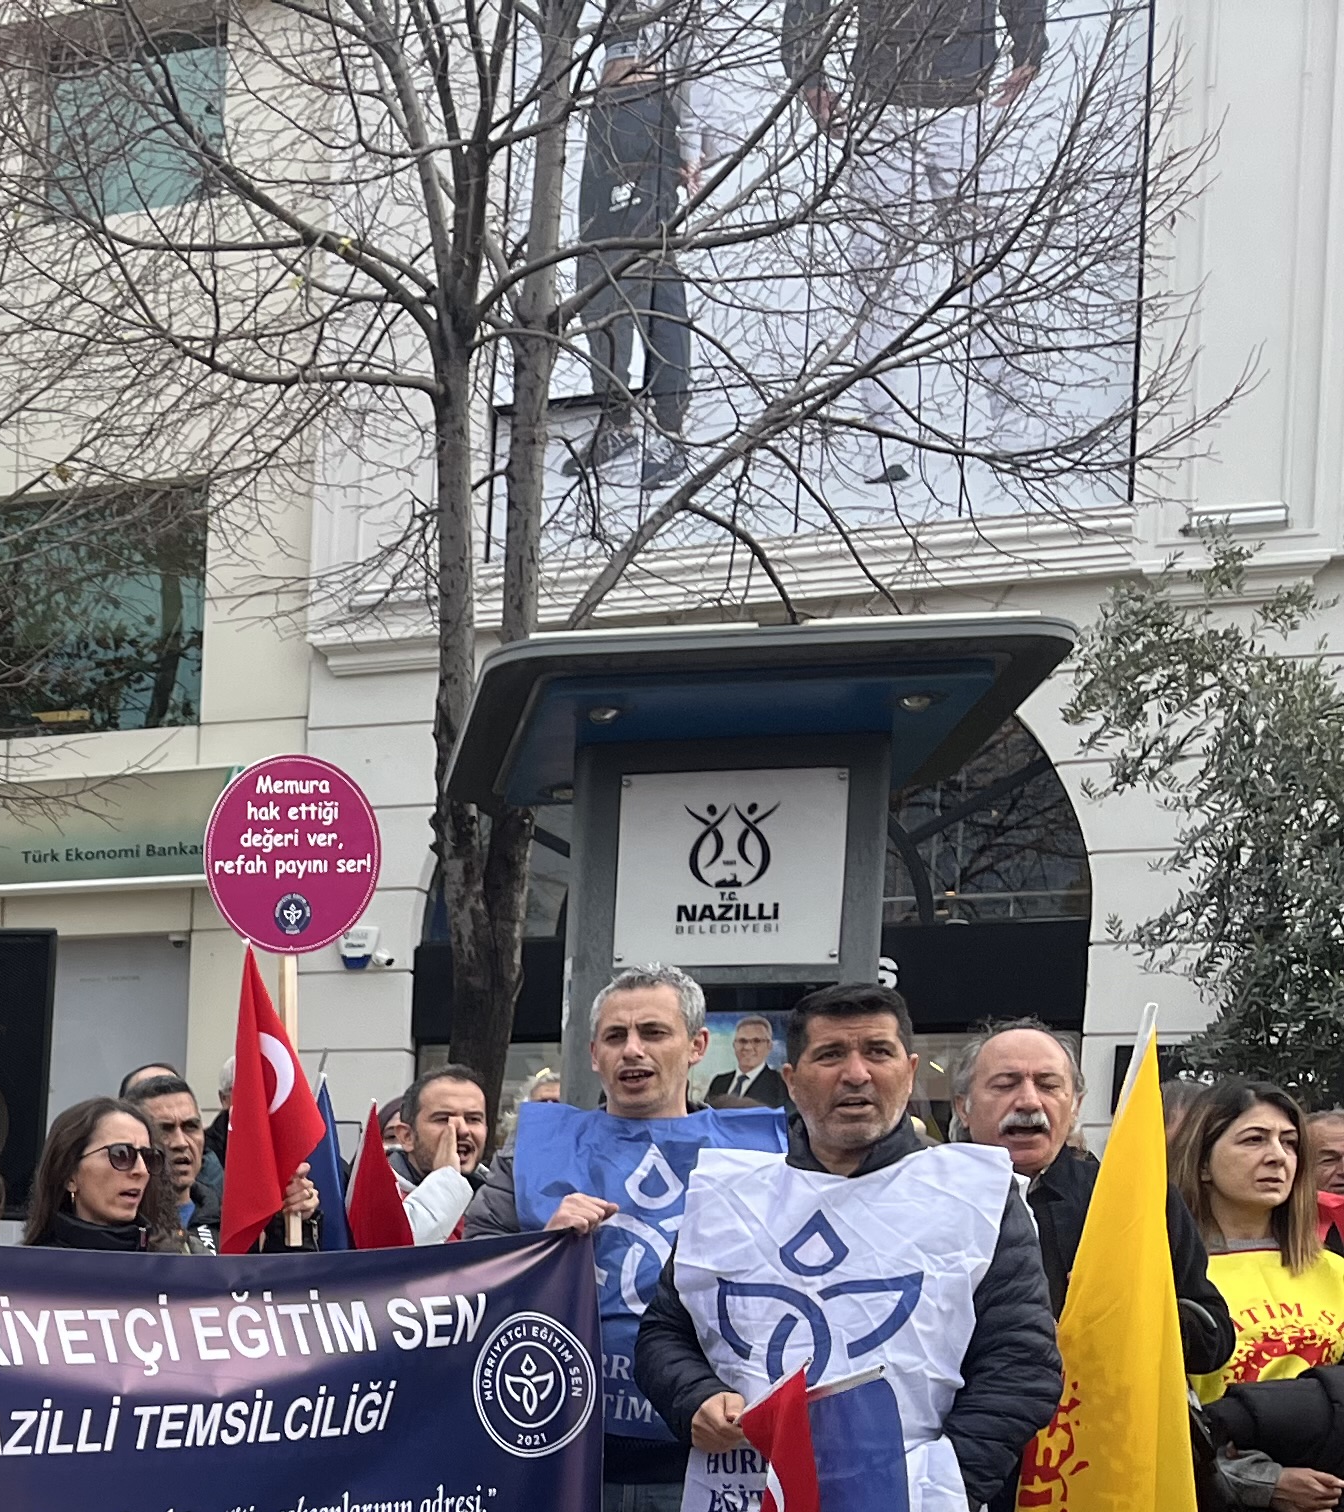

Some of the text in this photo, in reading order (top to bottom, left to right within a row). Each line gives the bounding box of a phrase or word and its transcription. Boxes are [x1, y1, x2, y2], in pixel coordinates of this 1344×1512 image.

[255, 775, 331, 796] Memura
[246, 800, 340, 827] hak ettiği
[239, 828, 345, 853] değeri ver,
[21, 843, 206, 866] Türk Ekonomi Bankas
[214, 854, 373, 880] refah payını ser!
[190, 1289, 378, 1363] EĞİTİM
[386, 1292, 488, 1352] SEN
[481, 1323, 527, 1401] HÜRRİYETÇİ
[531, 1325, 574, 1363] EĞİTİM
[568, 1366, 583, 1398] SEN
[132, 1380, 398, 1450] TEMSİLCİLİĞİ
[516, 1432, 548, 1446] 2021
